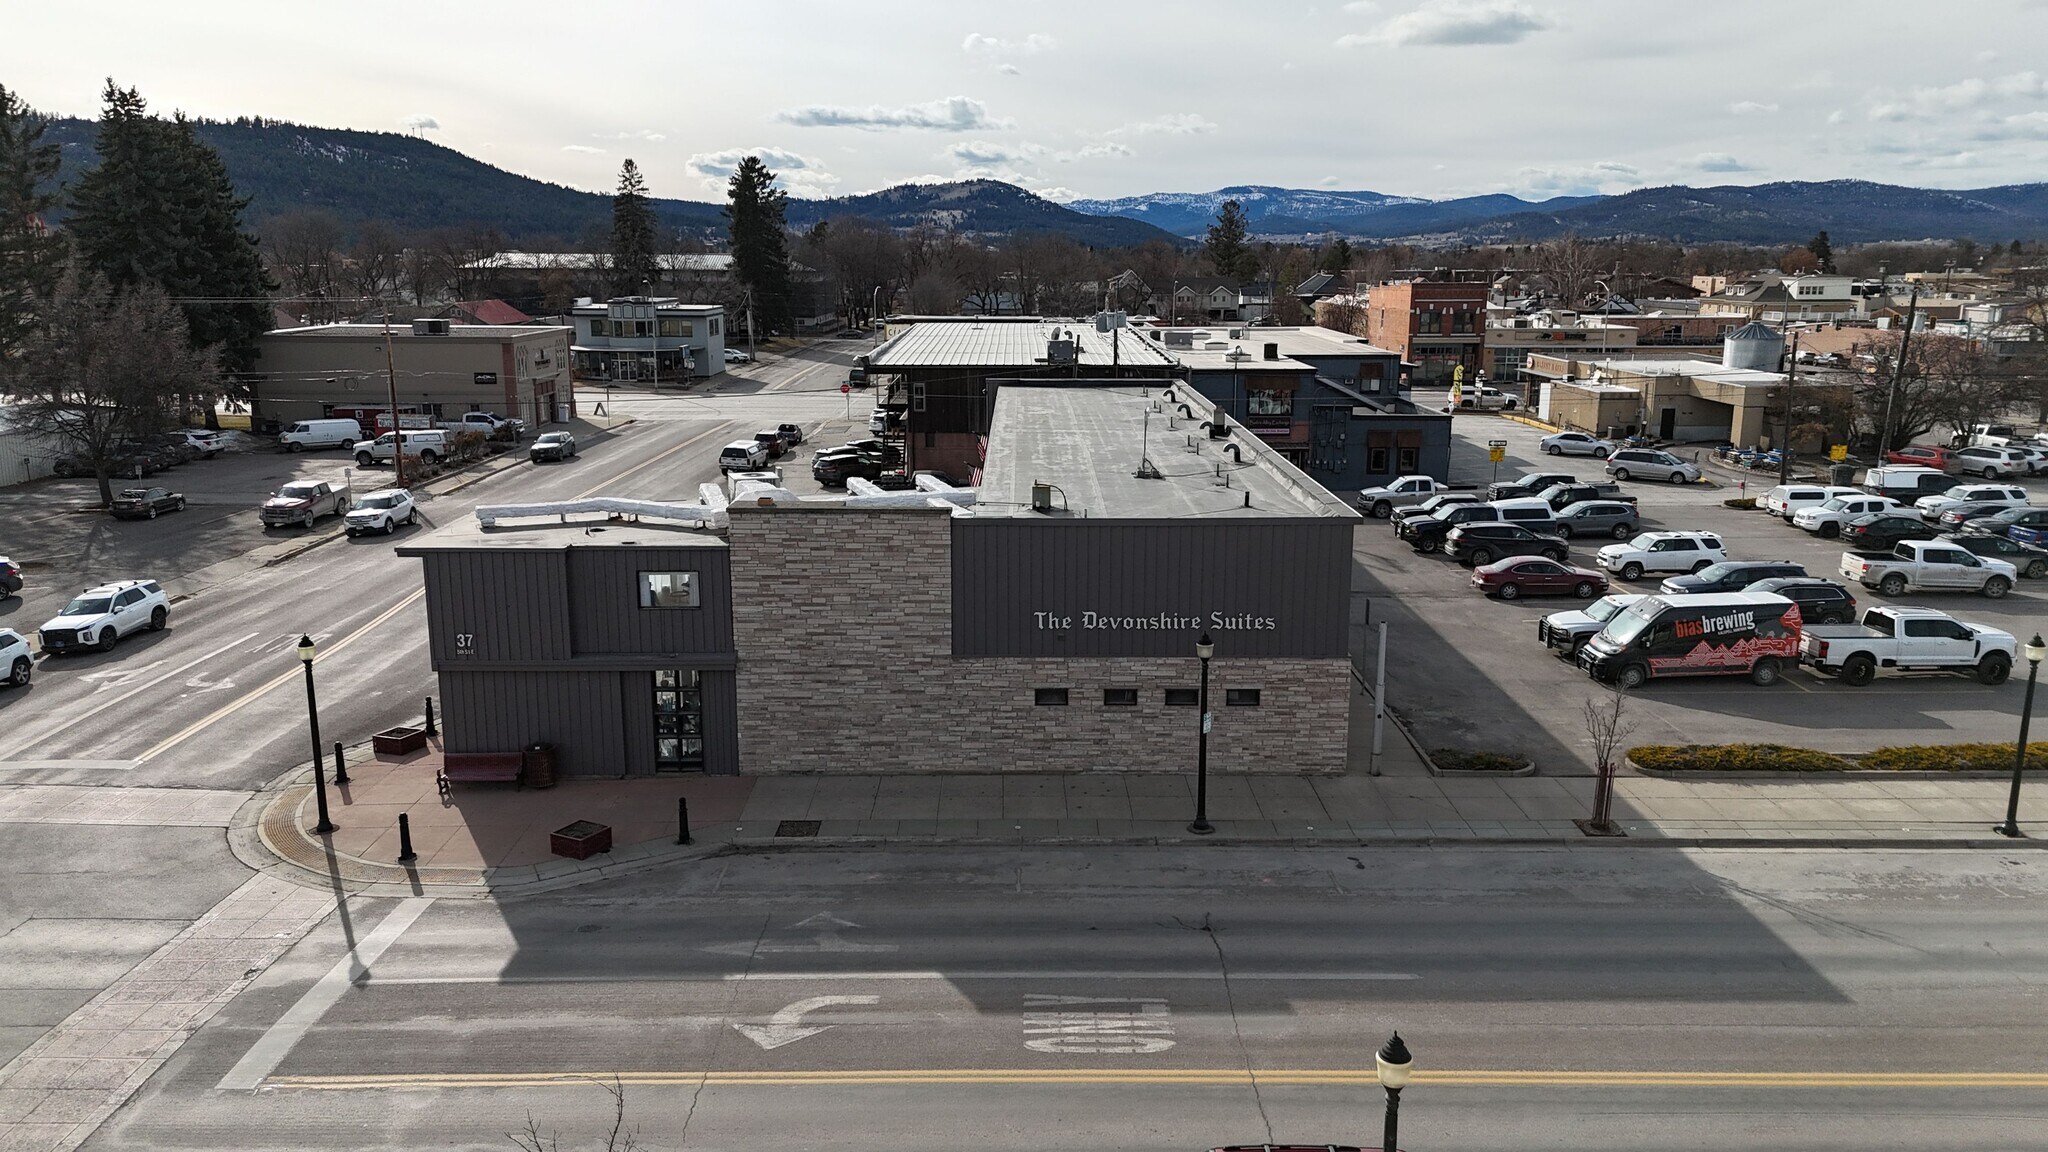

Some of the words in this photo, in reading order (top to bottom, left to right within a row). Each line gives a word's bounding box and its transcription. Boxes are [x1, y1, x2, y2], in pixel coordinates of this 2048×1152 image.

[1033, 611, 1072, 630] The
[1081, 610, 1201, 630] Devonshire
[1210, 610, 1276, 630] Suites
[457, 634, 473, 647] 37
[1023, 993, 1177, 1053] ONLY
